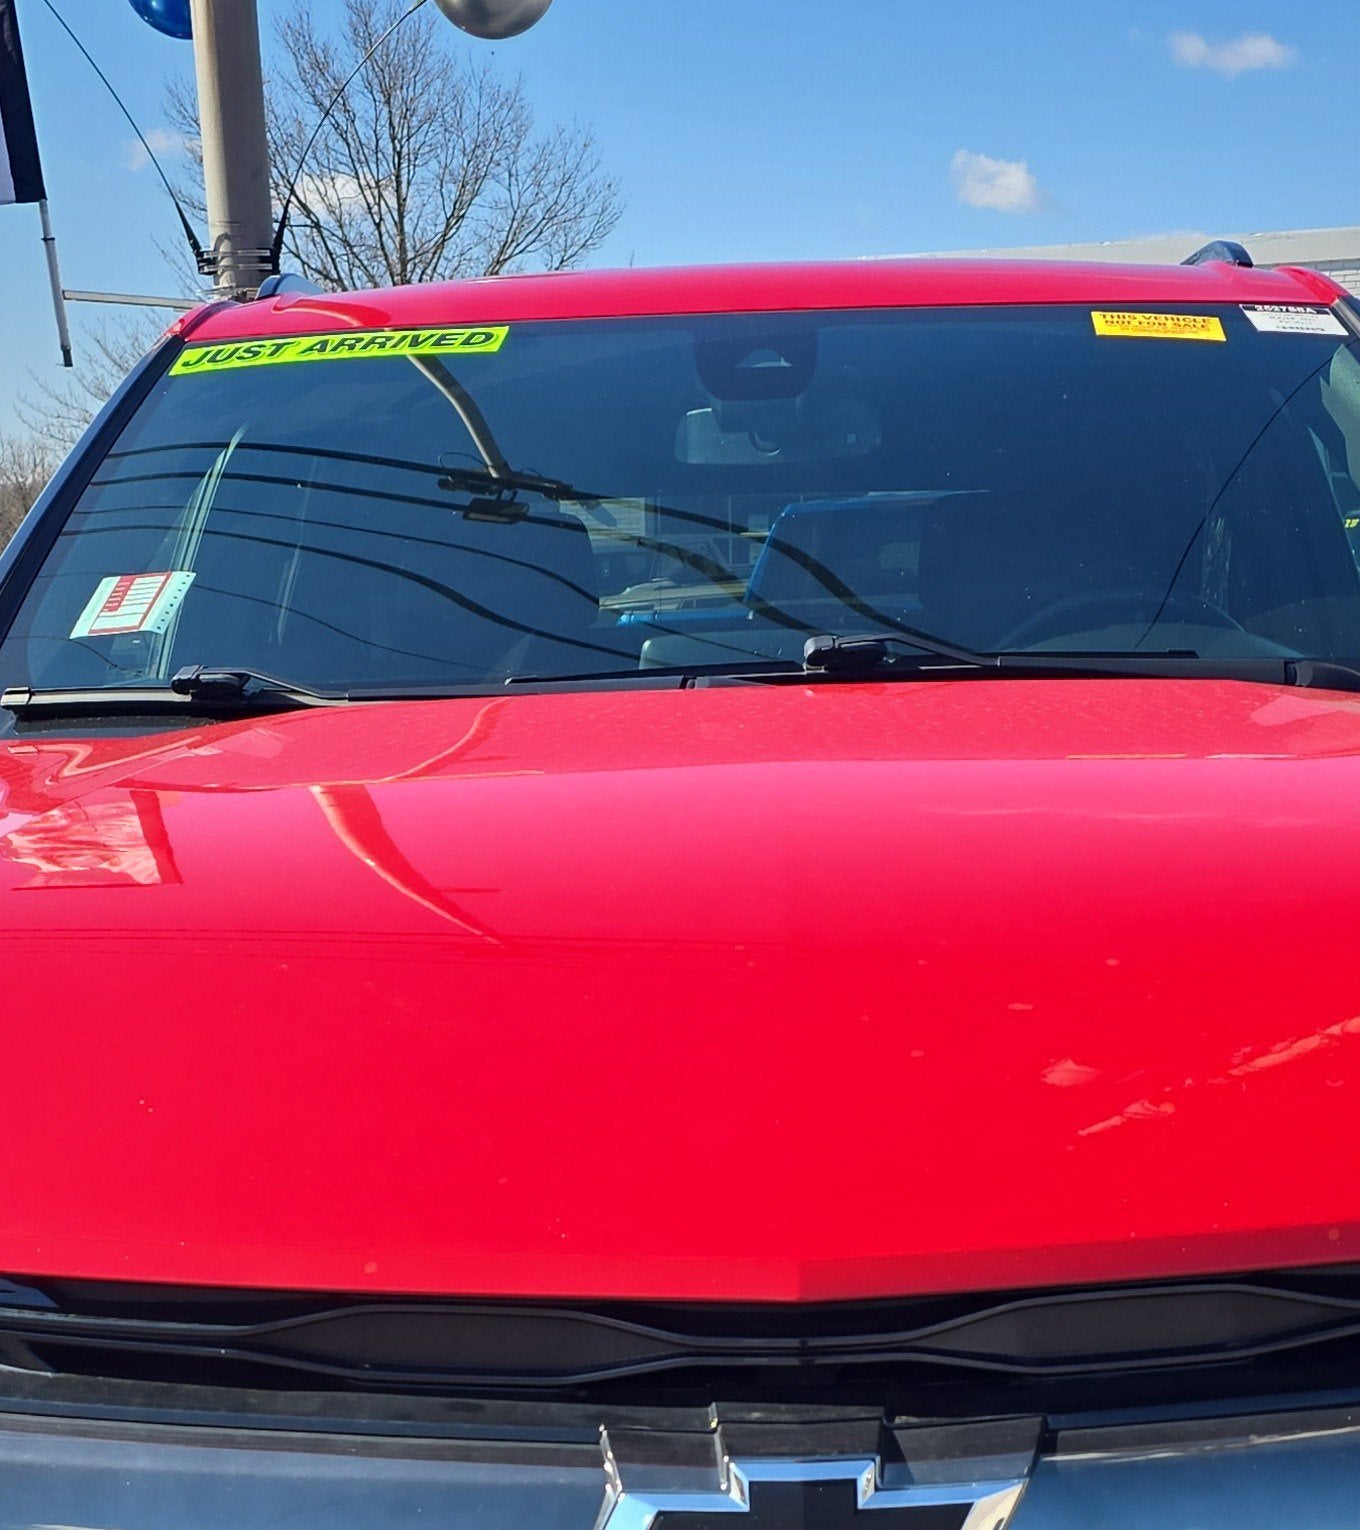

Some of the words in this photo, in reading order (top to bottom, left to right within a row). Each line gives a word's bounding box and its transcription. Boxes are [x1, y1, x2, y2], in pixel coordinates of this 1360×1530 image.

[1141, 314, 1212, 325] VEHICLE
[181, 341, 297, 369] JUST
[299, 331, 497, 356] ARRIVED
